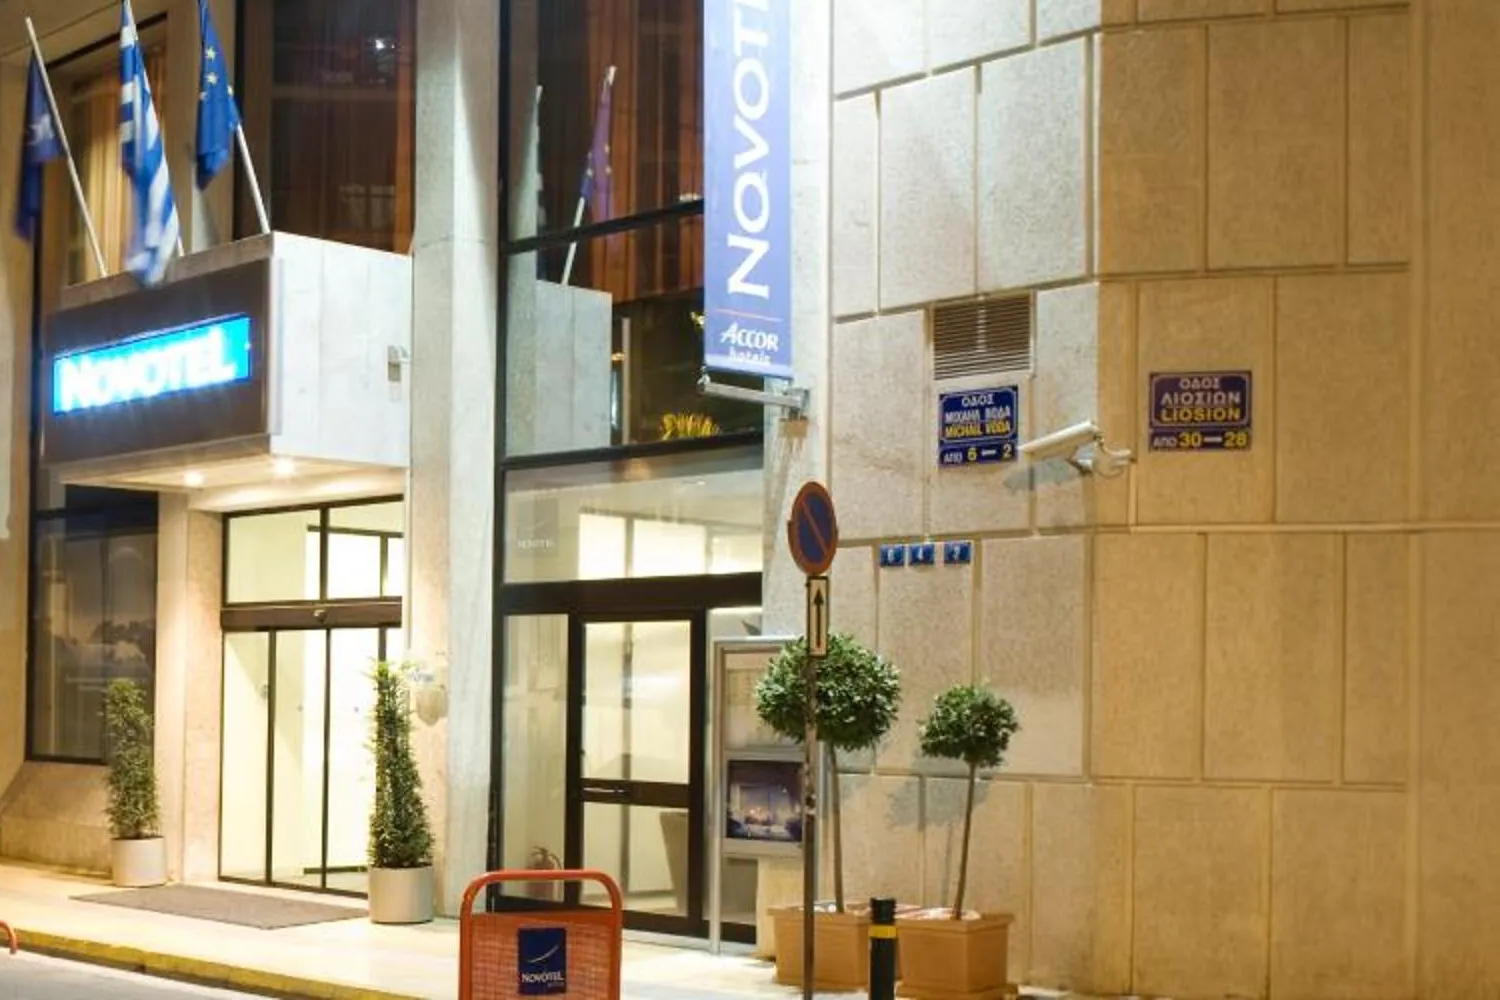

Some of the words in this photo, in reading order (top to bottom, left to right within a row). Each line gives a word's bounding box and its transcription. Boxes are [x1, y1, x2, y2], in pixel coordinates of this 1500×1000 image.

[60, 325, 238, 411] NOVOTEL
[1179, 377, 1221, 390] ΟΔΟΣ
[961, 393, 994, 407] ΟΔΟΣ
[1161, 391, 1241, 406] ΛΙΟΣΙΩΝ
[1161, 407, 1241, 422] LIOSION
[1179, 431, 1202, 447] 30
[1224, 431, 1248, 447] 28
[1003, 443, 1013, 458] 2
